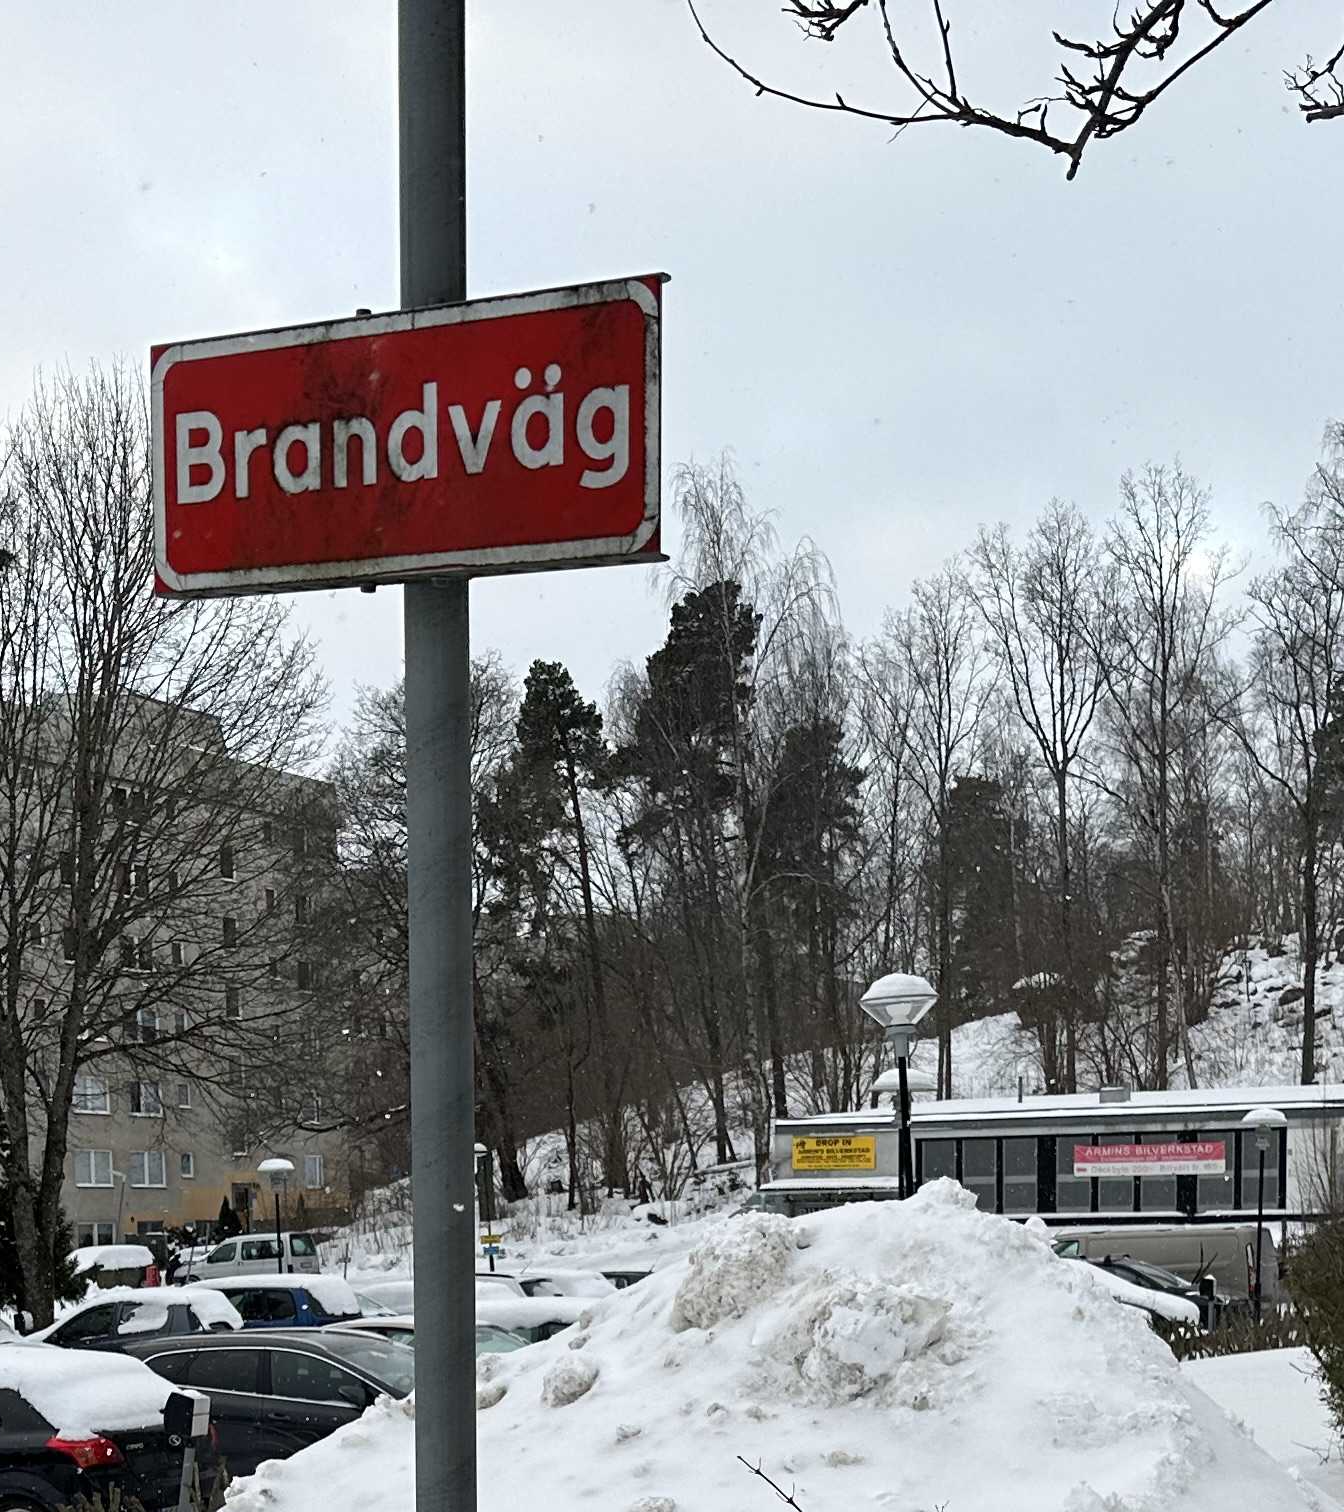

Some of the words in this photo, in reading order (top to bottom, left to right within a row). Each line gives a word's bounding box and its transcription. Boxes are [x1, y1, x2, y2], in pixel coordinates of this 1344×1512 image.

[175, 364, 630, 505] Brandväg
[842, 1138, 852, 1146] IN
[1085, 1145, 1131, 1156] ARMINS
[1135, 1144, 1214, 1155] BILVERKSTAD
